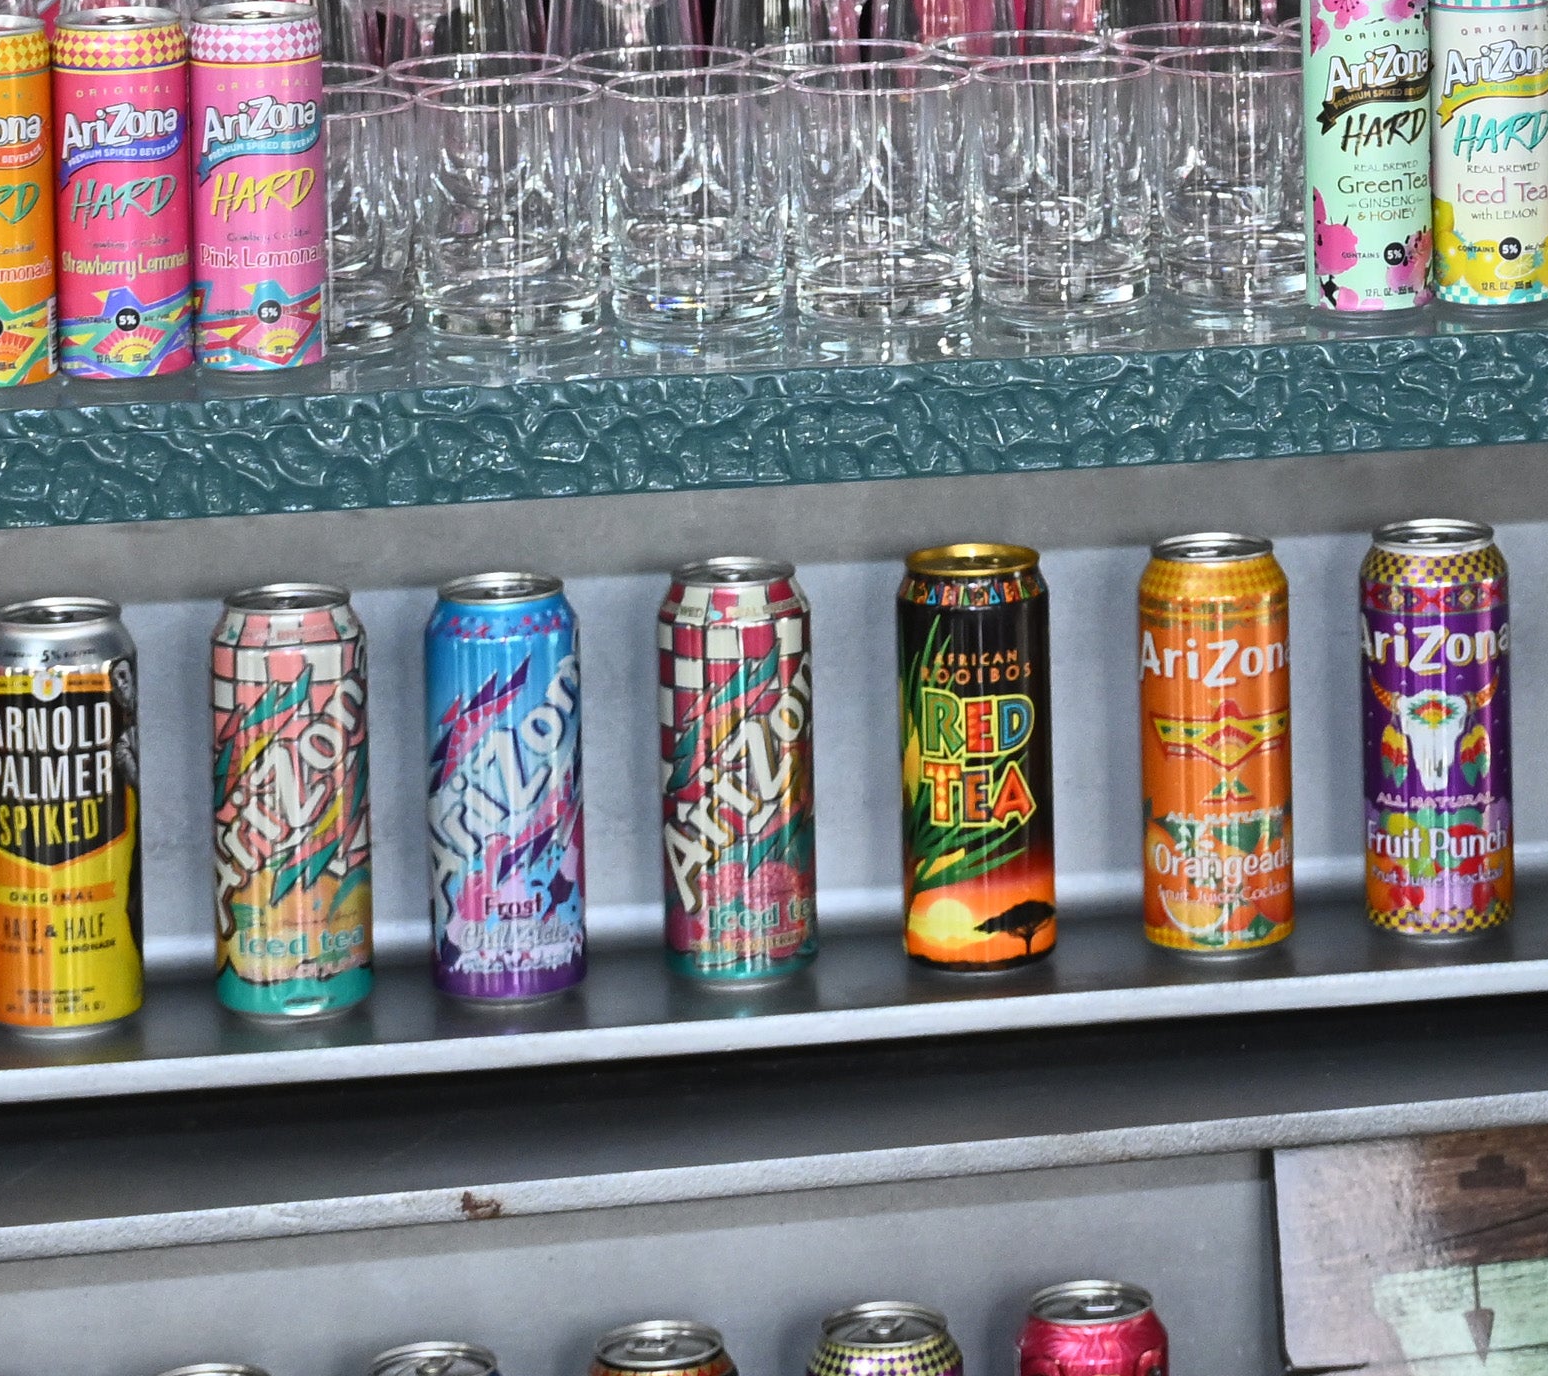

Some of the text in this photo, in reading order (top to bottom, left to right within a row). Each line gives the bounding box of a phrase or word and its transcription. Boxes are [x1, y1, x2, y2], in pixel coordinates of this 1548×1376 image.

[1344, 29, 1426, 42] ORIGINAL
[1461, 24, 1548, 37] ORIGINAL
[1325, 44, 1429, 102] AriZona
[62, 102, 179, 160] AriZona
[202, 95, 316, 153] AriZona
[1340, 108, 1427, 157] HARD
[1354, 159, 1419, 173] REAL BREWED
[1466, 162, 1540, 174] REAL BREWED
[211, 168, 316, 223] HARD
[1337, 172, 1428, 194] Green Tea
[1457, 177, 1548, 204] Iced Tea
[70, 174, 177, 229] HARD
[1357, 207, 1417, 222] & HONEY
[1358, 194, 1416, 209] GINSENG
[1471, 207, 1539, 221] with LEMON
[62, 245, 190, 280] Strawberry Lemonad
[200, 240, 324, 268] Pink Lemona
[934, 649, 1019, 667] AFRICAN
[920, 662, 1033, 685] ROOIBOS
[921, 686, 1035, 760] RED
[663, 651, 813, 915] AriZon
[921, 755, 1037, 830] TEA
[1368, 819, 1507, 860] Fruit Punch
[484, 891, 542, 920] Frost
[708, 901, 780, 930] Iced
[3, 913, 105, 942] HALF & HALF
[238, 924, 365, 958] Iced tea
